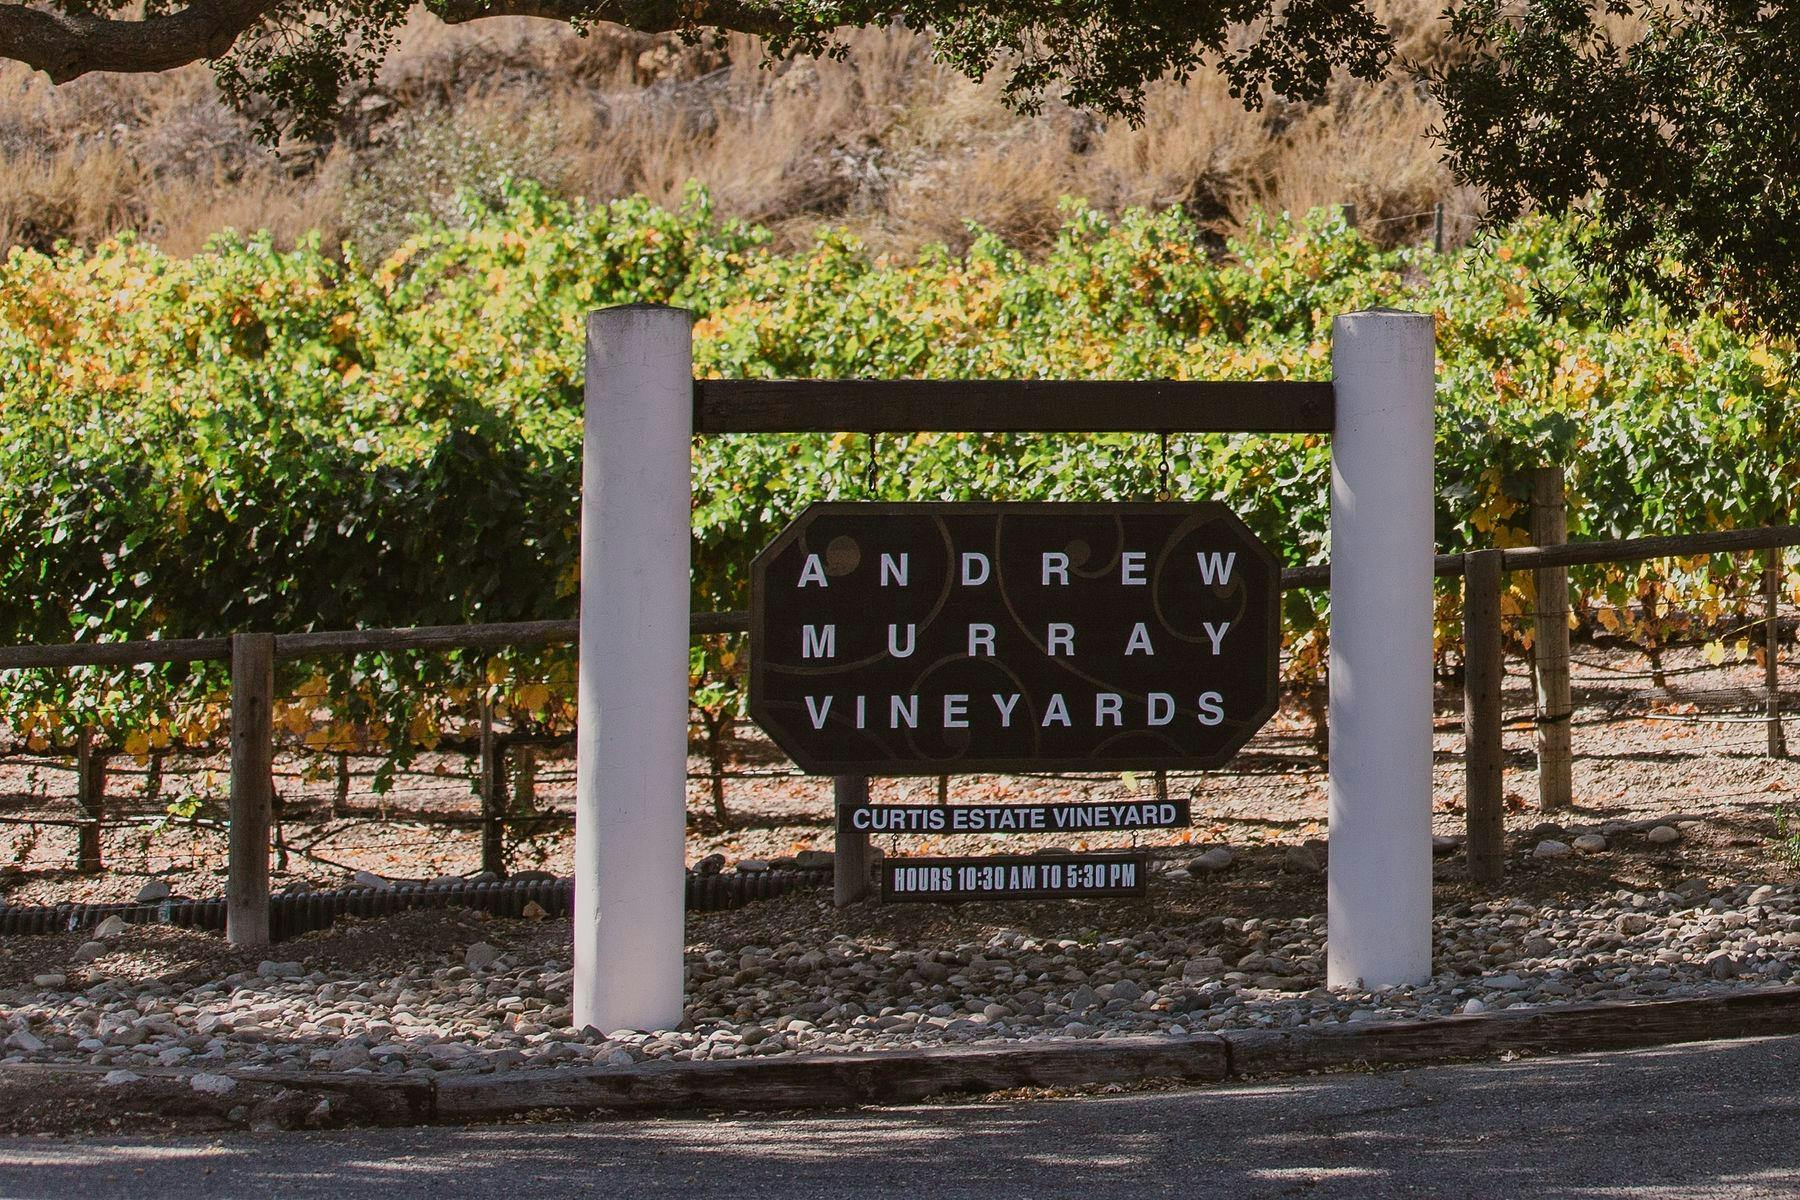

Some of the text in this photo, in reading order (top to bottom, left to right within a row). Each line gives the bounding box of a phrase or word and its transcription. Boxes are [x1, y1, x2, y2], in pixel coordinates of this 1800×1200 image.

[797, 551, 1236, 587] ANDREW
[801, 622, 1230, 658] MURRAY
[805, 692, 1224, 729] VINEYARDS
[853, 804, 1176, 830] CURTIS ESTATE VINEYARD
[894, 863, 1135, 892] HOURS 10:30 AM TO 5:30 PM
